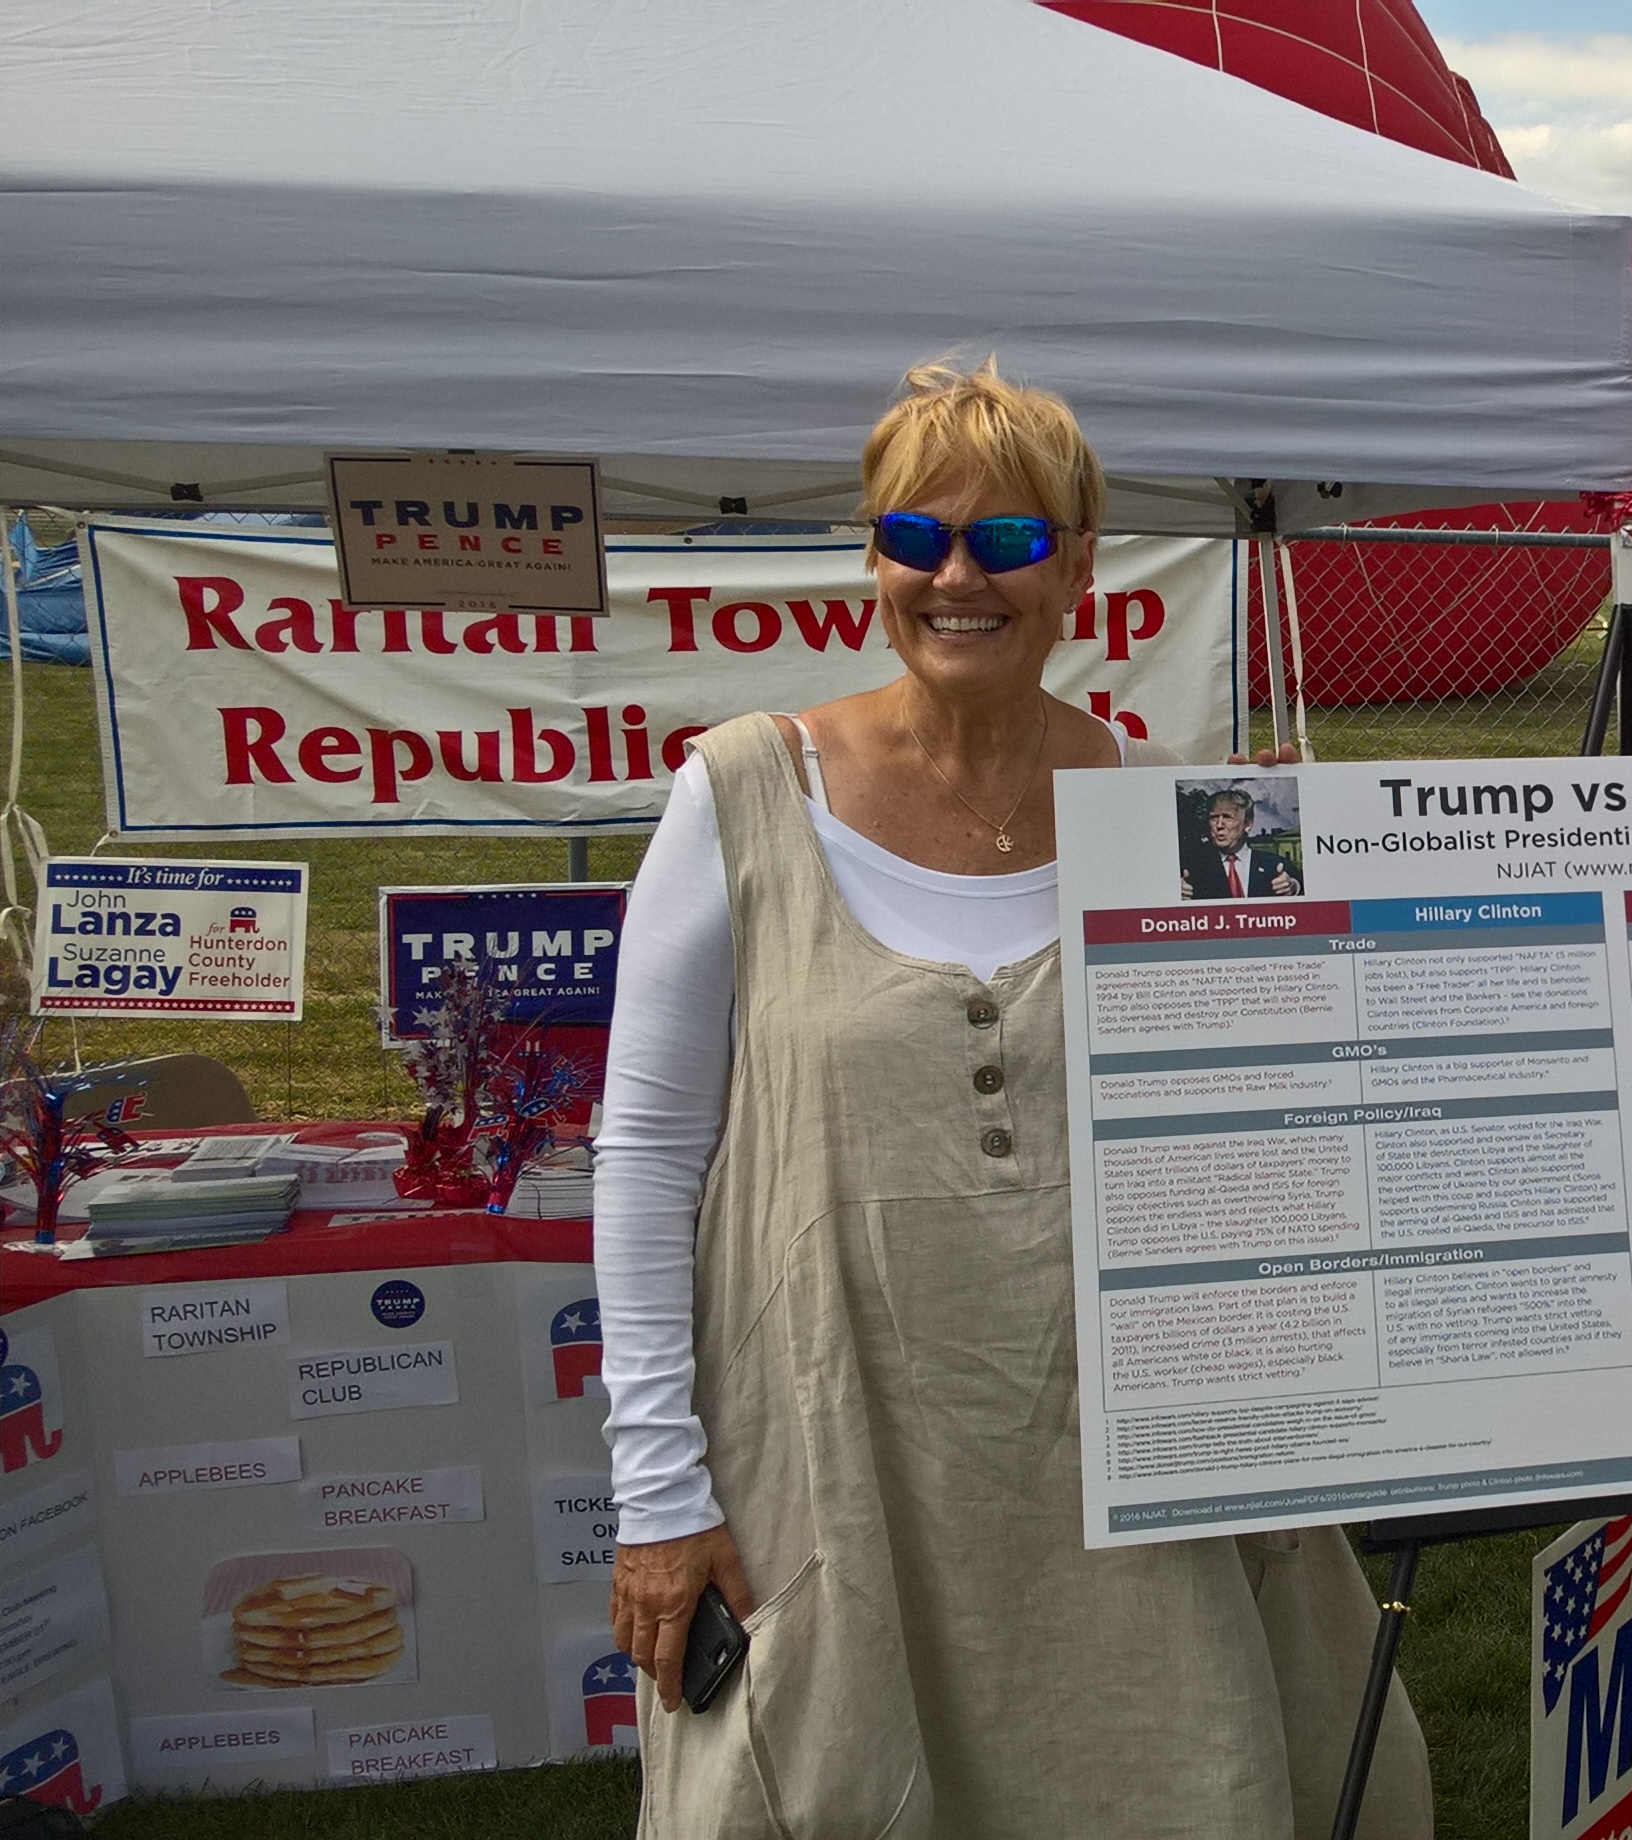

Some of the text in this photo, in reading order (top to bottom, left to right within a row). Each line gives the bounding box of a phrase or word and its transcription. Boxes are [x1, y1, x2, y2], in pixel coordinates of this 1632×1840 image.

[350, 500, 584, 531] TRUMP
[375, 533, 563, 555] PENCE
[371, 557, 571, 572] MAKE AMERICA GREAT AGAIN!
[647, 586, 1165, 661] Towip
[217, 704, 708, 804] Republic
[1380, 777, 1554, 824] Trump
[1571, 782, 1626, 812] vs
[1316, 829, 1495, 854] Non-Globalist
[126, 868, 224, 890] It's time for
[1497, 861, 1557, 879] NJIAT
[66, 890, 126, 909] John
[51, 903, 181, 937] Lanza
[1141, 913, 1296, 932] Donald J. Trump
[1415, 903, 1541, 923] Hillary Clinton
[206, 921, 226, 937] for
[63, 942, 166, 963] Suzanne
[189, 935, 288, 952] Hunterdon
[401, 928, 614, 960] TRUMP
[1328, 938, 1376, 950] Trade
[188, 953, 256, 971] County
[1095, 970, 1129, 979] Donald
[1132, 968, 1161, 977] Trump
[1164, 968, 1205, 976] opposes
[1207, 966, 1222, 974] the
[48, 956, 183, 996] Lagay
[188, 971, 290, 988] Freeholder
[1095, 980, 1151, 991] agreements
[1154, 979, 1176, 987] such
[1235, 975, 1254, 983] that
[1277, 972, 1309, 982] passed
[514, 988, 553, 997] GREAT
[557, 986, 601, 996] AGAIN!
[1153, 988, 1187, 997] Clinton
[1273, 983, 1302, 994] Hillary
[1332, 1044, 1387, 1057] GMO's
[1100, 1079, 1134, 1087] Donald
[1137, 1077, 1166, 1087] Trump
[1170, 1076, 1210, 1086] opposes
[1243, 1072, 1261, 1081] and
[1263, 1070, 1294, 1080] forced
[1284, 1105, 1441, 1126] Foreign Policy/Iraq
[1258, 1247, 1483, 1276] Open Borders/Immigration
[1109, 1295, 1145, 1307] Donald
[1148, 1293, 1180, 1304] Trump
[1201, 1288, 1239, 1299] enforce
[1241, 1286, 1258, 1297] the
[1260, 1284, 1297, 1295] borders
[1300, 1282, 1318, 1291] and
[1320, 1279, 1357, 1290] enforce
[150, 1298, 251, 1323] RARITAN
[153, 1323, 277, 1351] TOWNSHIP
[298, 1349, 444, 1380] REPUBLICAN
[302, 1384, 362, 1406] CLUB
[138, 1462, 267, 1488] APPLEBEES
[321, 1477, 424, 1500] PANCAKE
[19, 1492, 89, 1532] FACEBOOK
[324, 1503, 451, 1527] BREAKFAST
[554, 1497, 616, 1514] TICKE
[592, 1523, 619, 1539] ON
[561, 1550, 615, 1566] SALE
[159, 1729, 281, 1752] APPLEBEES
[348, 1723, 448, 1748] PANCAKE
[350, 1748, 475, 1776] BREAKFAST
